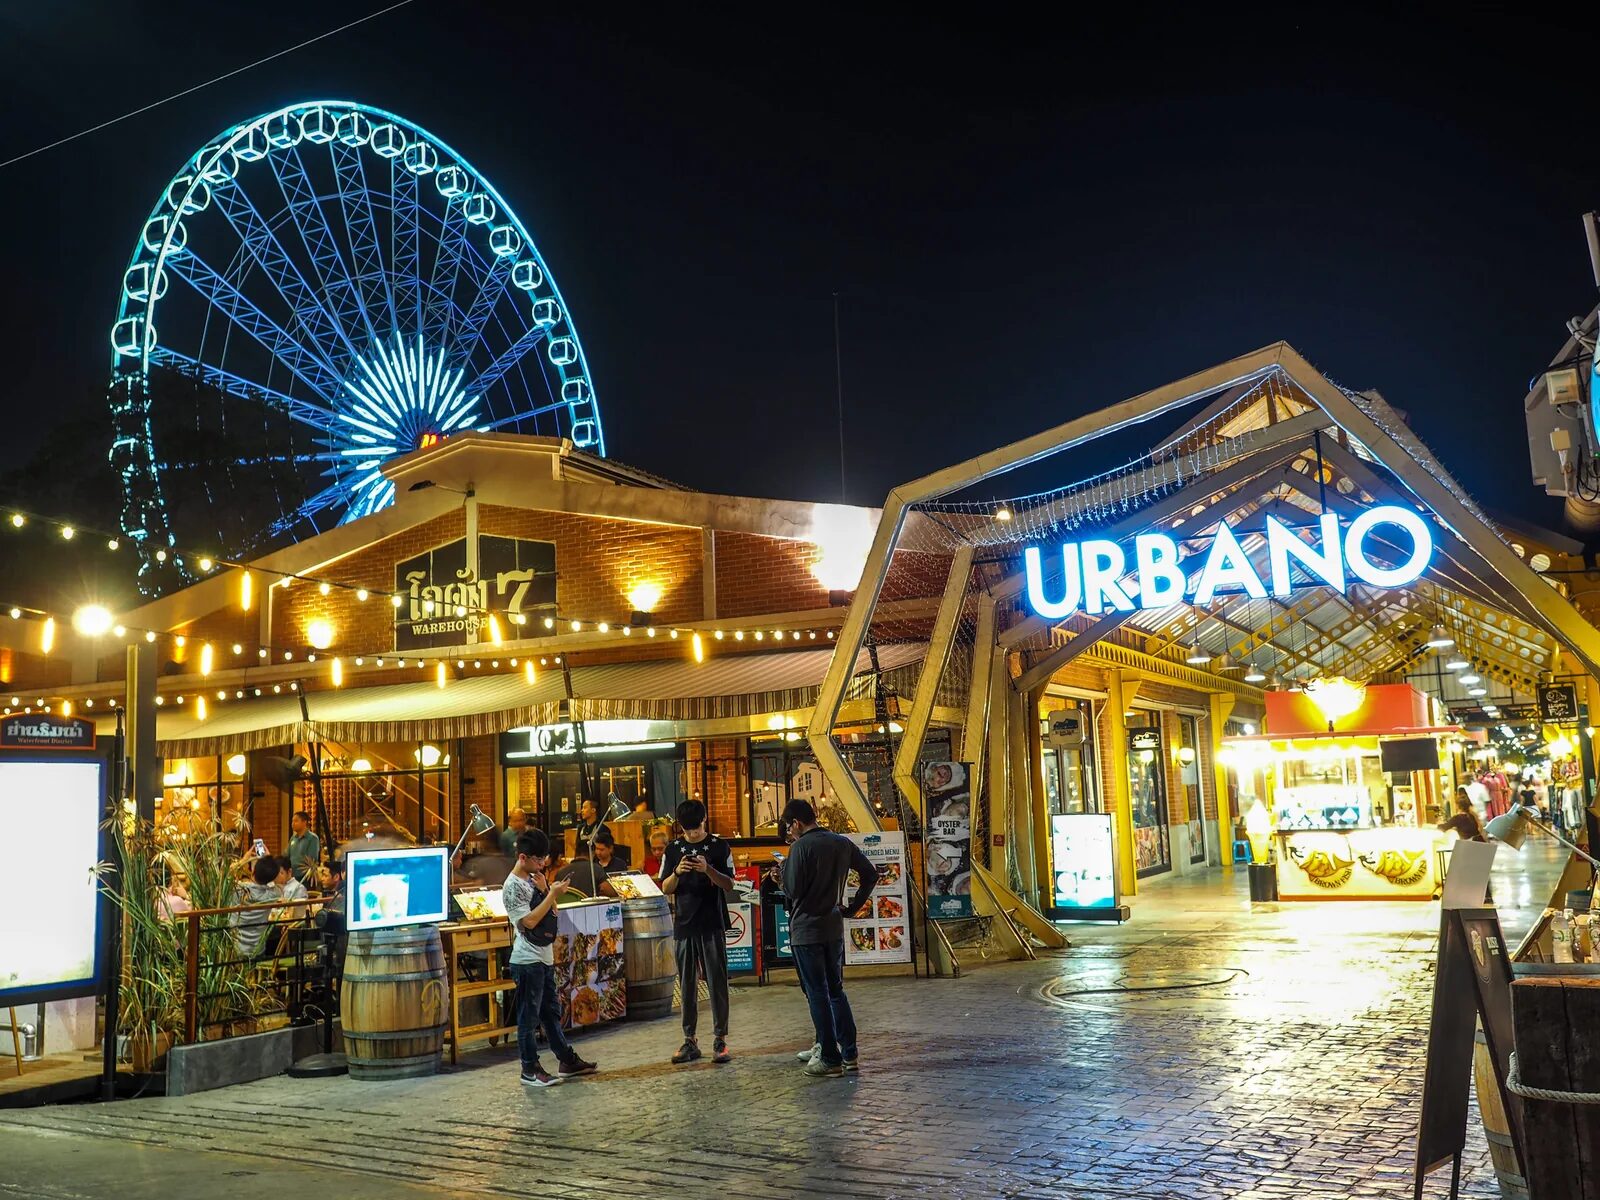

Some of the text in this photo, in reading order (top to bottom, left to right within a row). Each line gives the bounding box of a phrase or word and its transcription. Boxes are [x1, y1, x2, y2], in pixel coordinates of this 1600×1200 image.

[1024, 505, 1434, 619] URBANO
[496, 568, 536, 624] 7
[411, 617, 489, 636] WAREHOUSE
[17, 737, 50, 745] Waterfront
[937, 820, 961, 828] OYSTER
[942, 827, 956, 836] BAR
[861, 848, 900, 857] MENDED MENU
[1313, 876, 1341, 889] BROWN
[1394, 872, 1422, 886] BROWN
